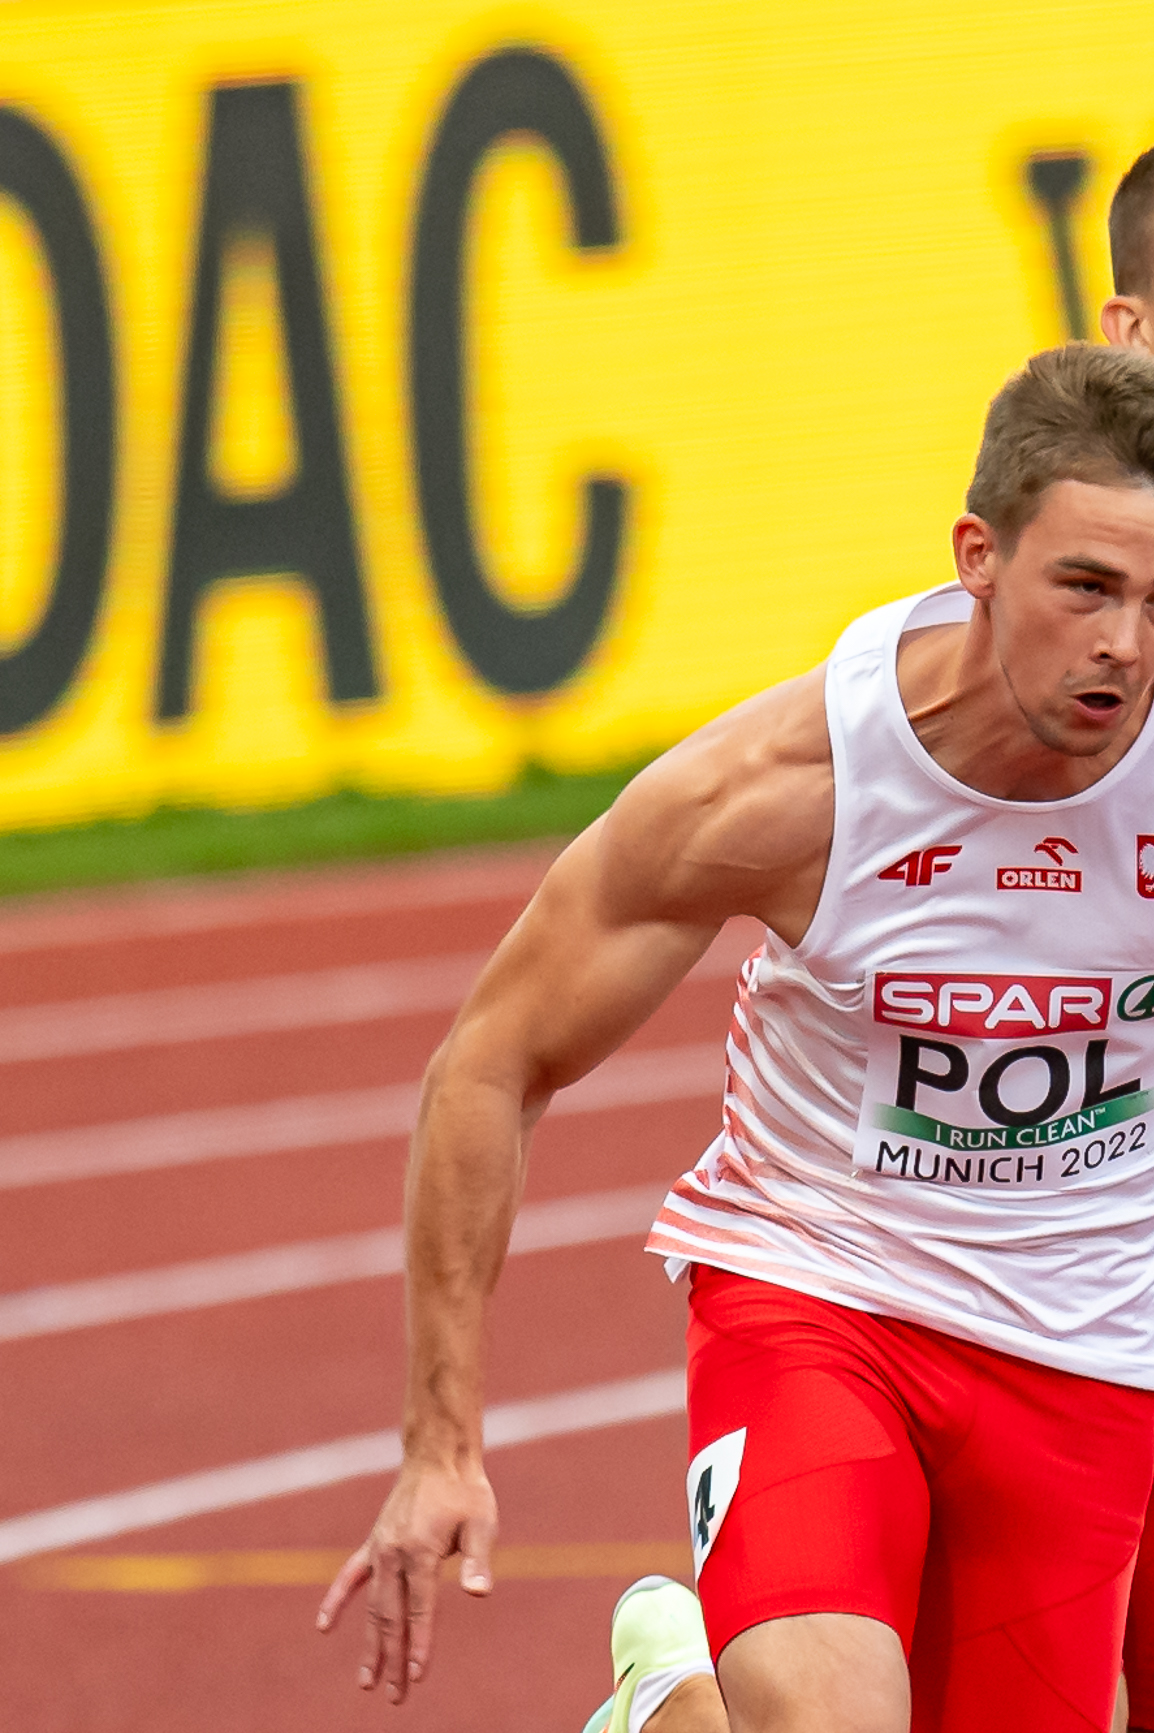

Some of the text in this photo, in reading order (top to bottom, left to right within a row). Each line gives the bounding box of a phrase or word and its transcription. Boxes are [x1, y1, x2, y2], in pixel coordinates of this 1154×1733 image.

[877, 845, 963, 886] 4F
[1001, 870, 1076, 889] ORLEN
[880, 981, 1105, 1030] SPAR
[896, 1034, 1142, 1128] POL
[875, 1121, 1147, 1183] MUNICH 2022
[935, 1124, 942, 1142] I
[950, 1130, 1007, 1148] RUN
